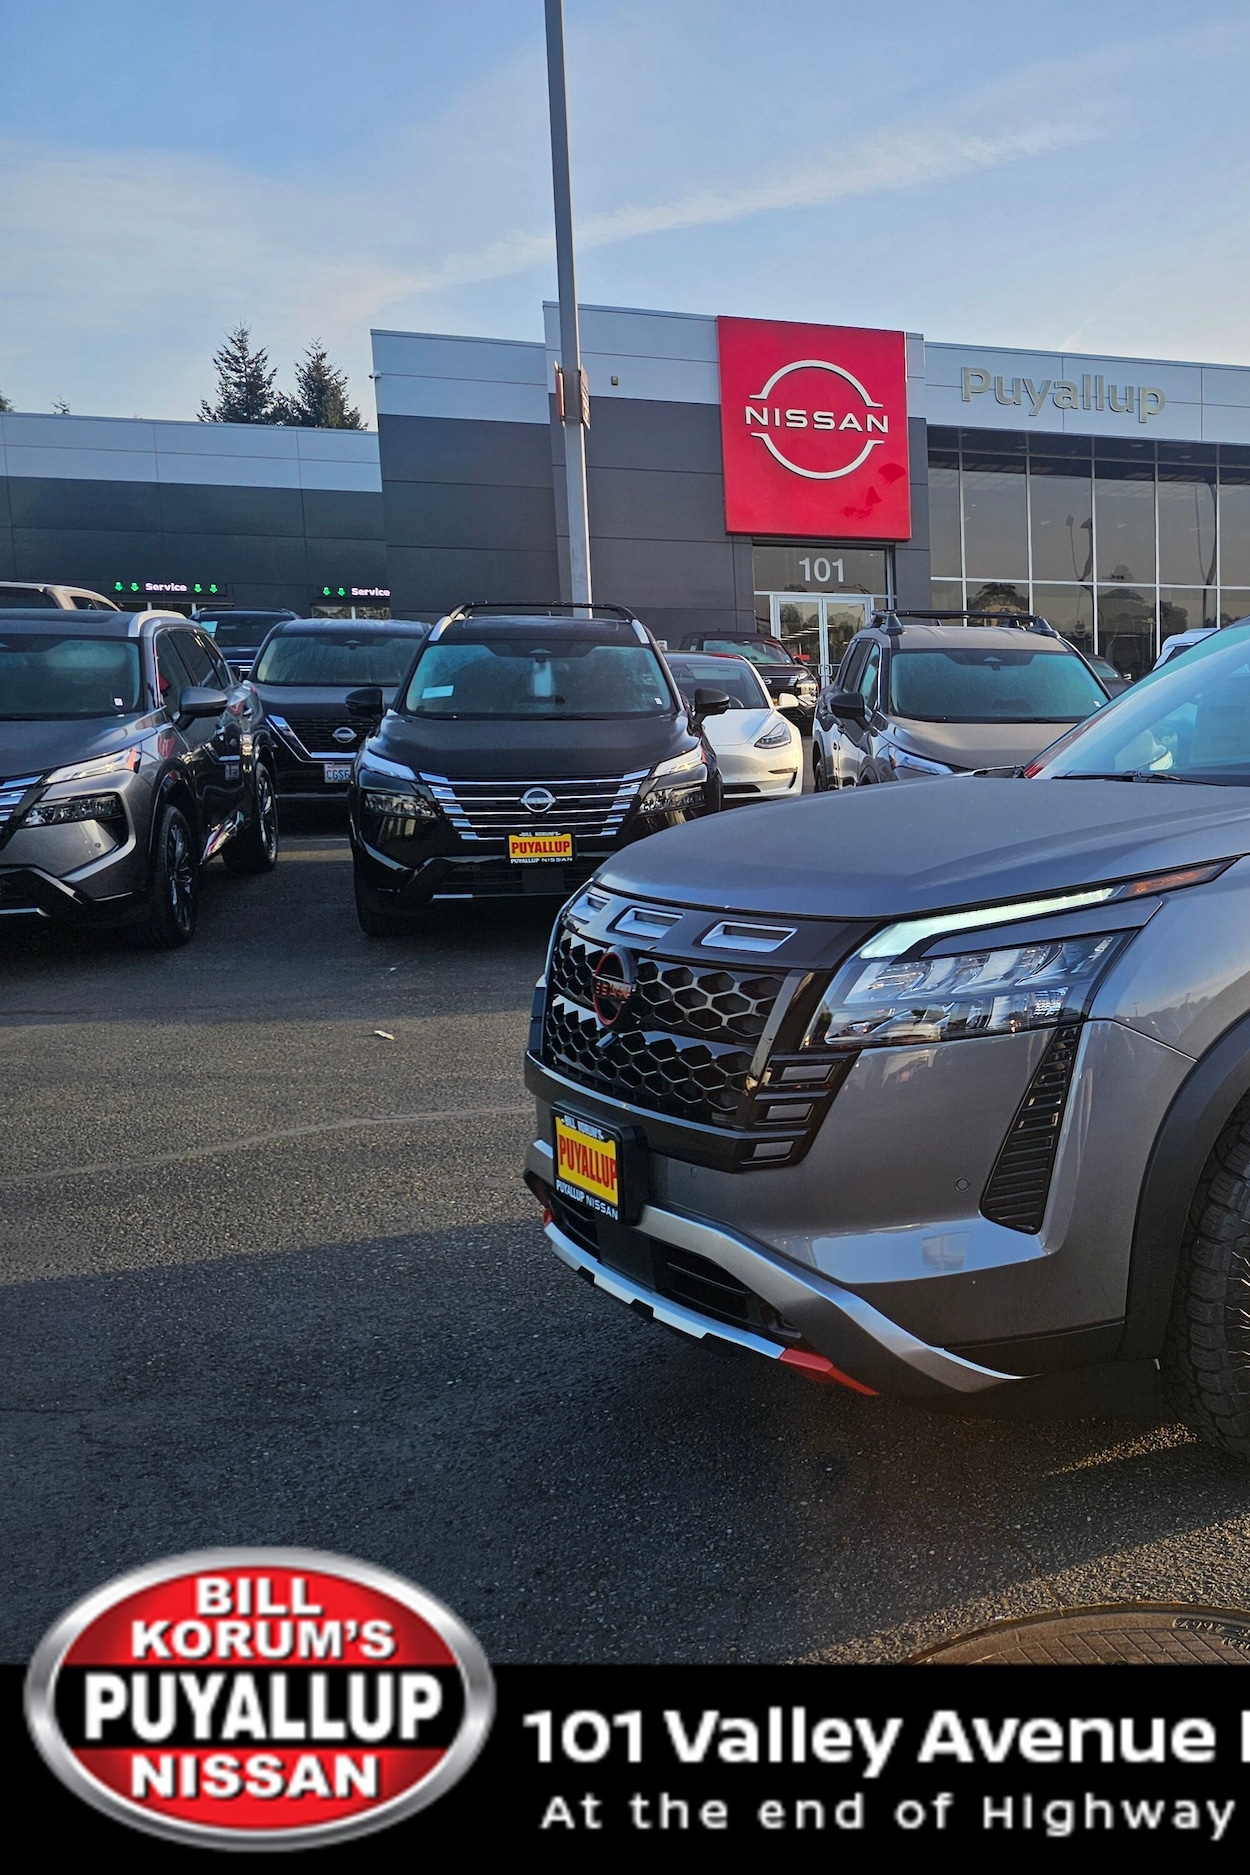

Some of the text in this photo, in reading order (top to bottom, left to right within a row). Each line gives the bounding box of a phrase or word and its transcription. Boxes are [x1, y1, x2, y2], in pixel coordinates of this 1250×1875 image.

[961, 366, 1167, 424] Puyallup
[744, 405, 890, 435] NISSAN
[798, 556, 845, 583] 101
[145, 582, 188, 593] Service
[351, 587, 391, 597] Service
[511, 841, 570, 854] PUYALLUP
[558, 1134, 618, 1191] PUYALLUP
[556, 1179, 619, 1221] PUYALLUP NISSAN
